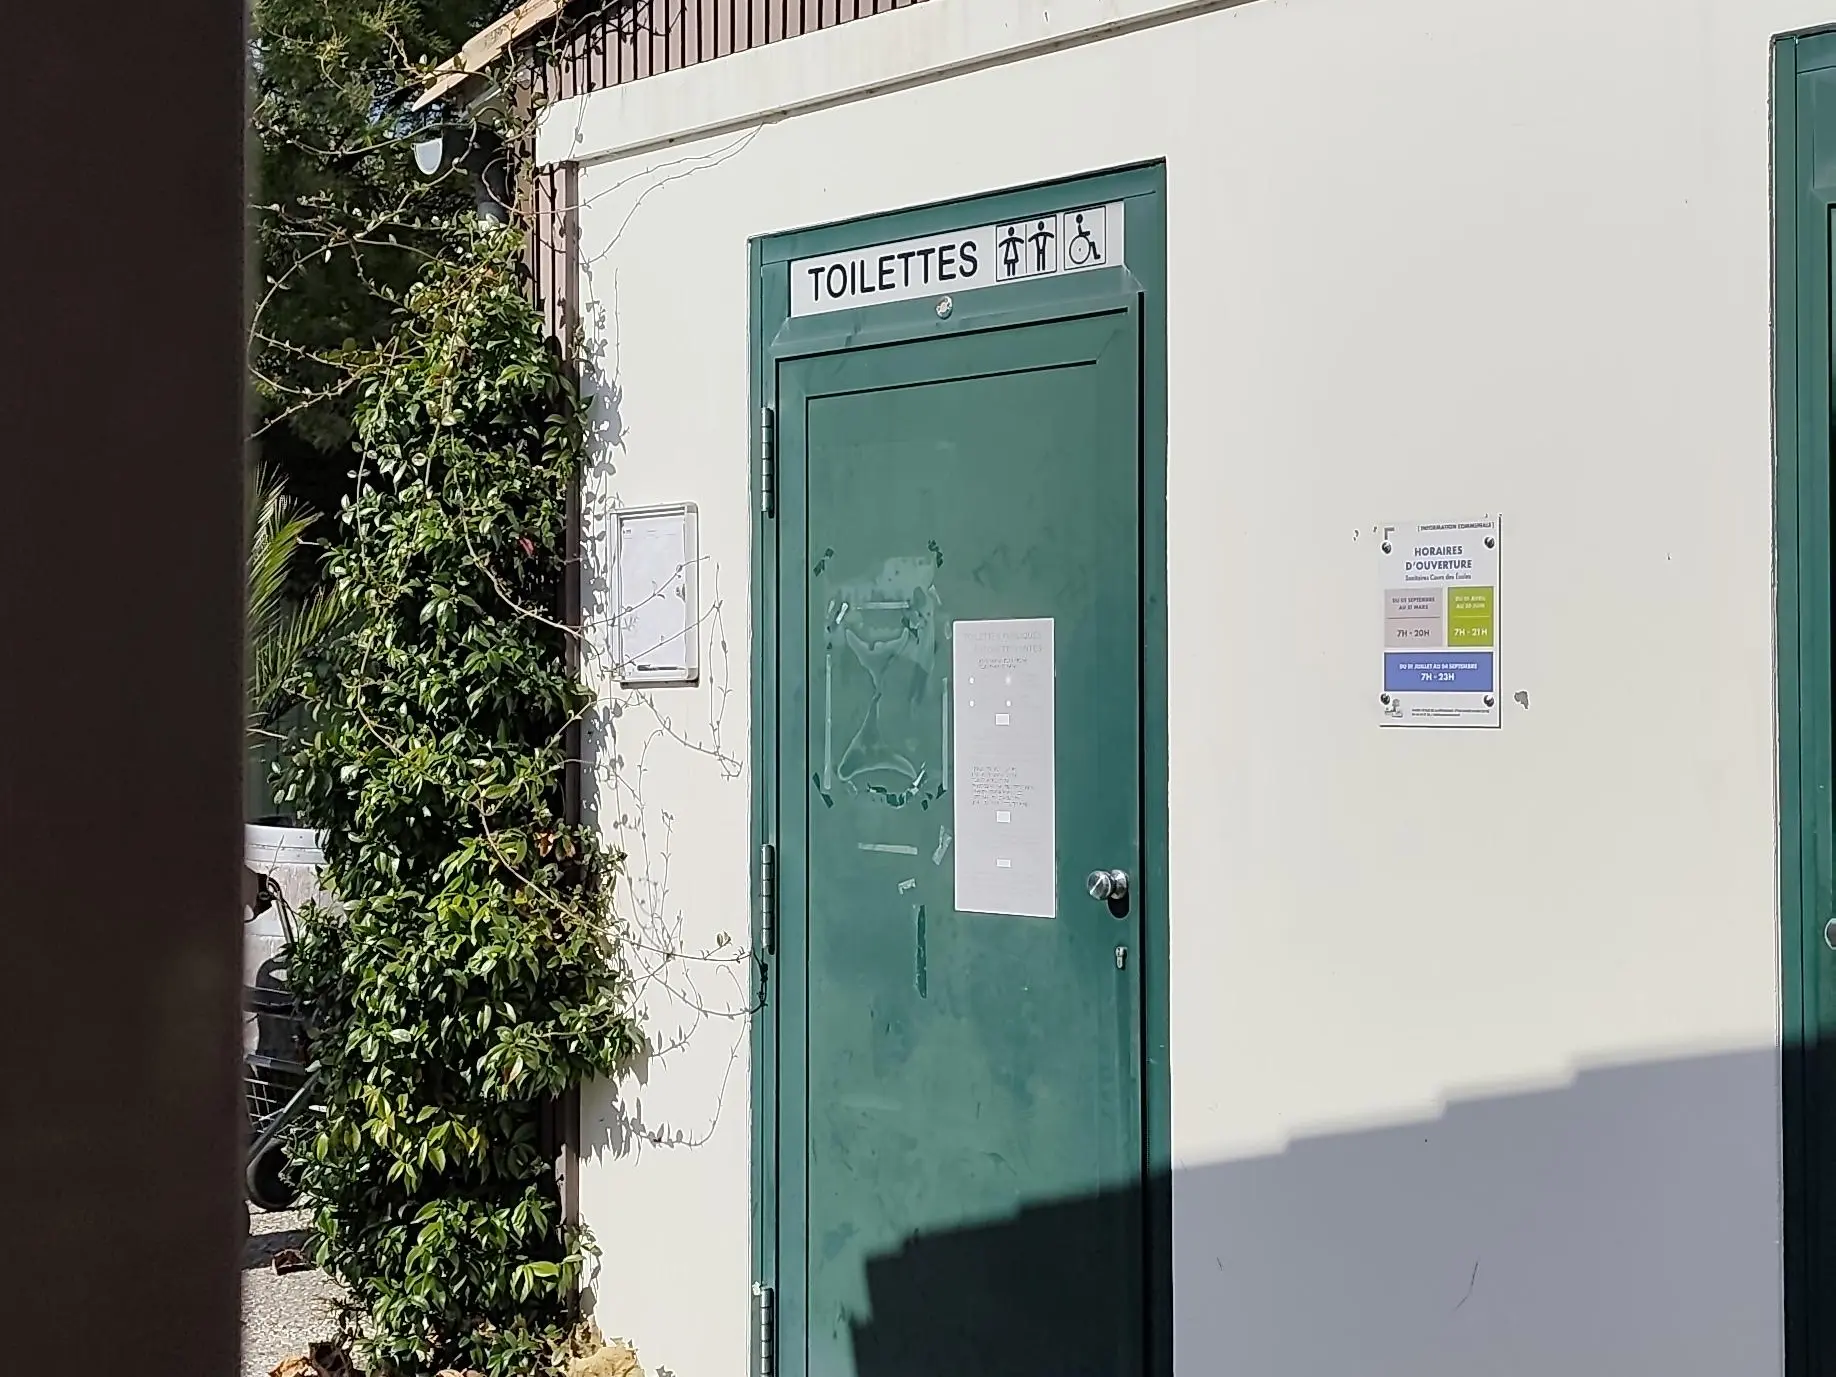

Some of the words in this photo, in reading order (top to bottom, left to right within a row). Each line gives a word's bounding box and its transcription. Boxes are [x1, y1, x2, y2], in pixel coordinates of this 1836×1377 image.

[807, 240, 978, 303] TOILETTES
[1414, 545, 1463, 557] HORAIRES
[1405, 559, 1472, 571] D'OUVERTURE
[1397, 629, 1408, 638] 7H
[1414, 629, 1430, 637] 20H
[1454, 628, 1466, 637] 7H
[1471, 628, 1488, 637] 21H
[1420, 672, 1433, 681] 7H
[1438, 672, 1455, 681] 23H
